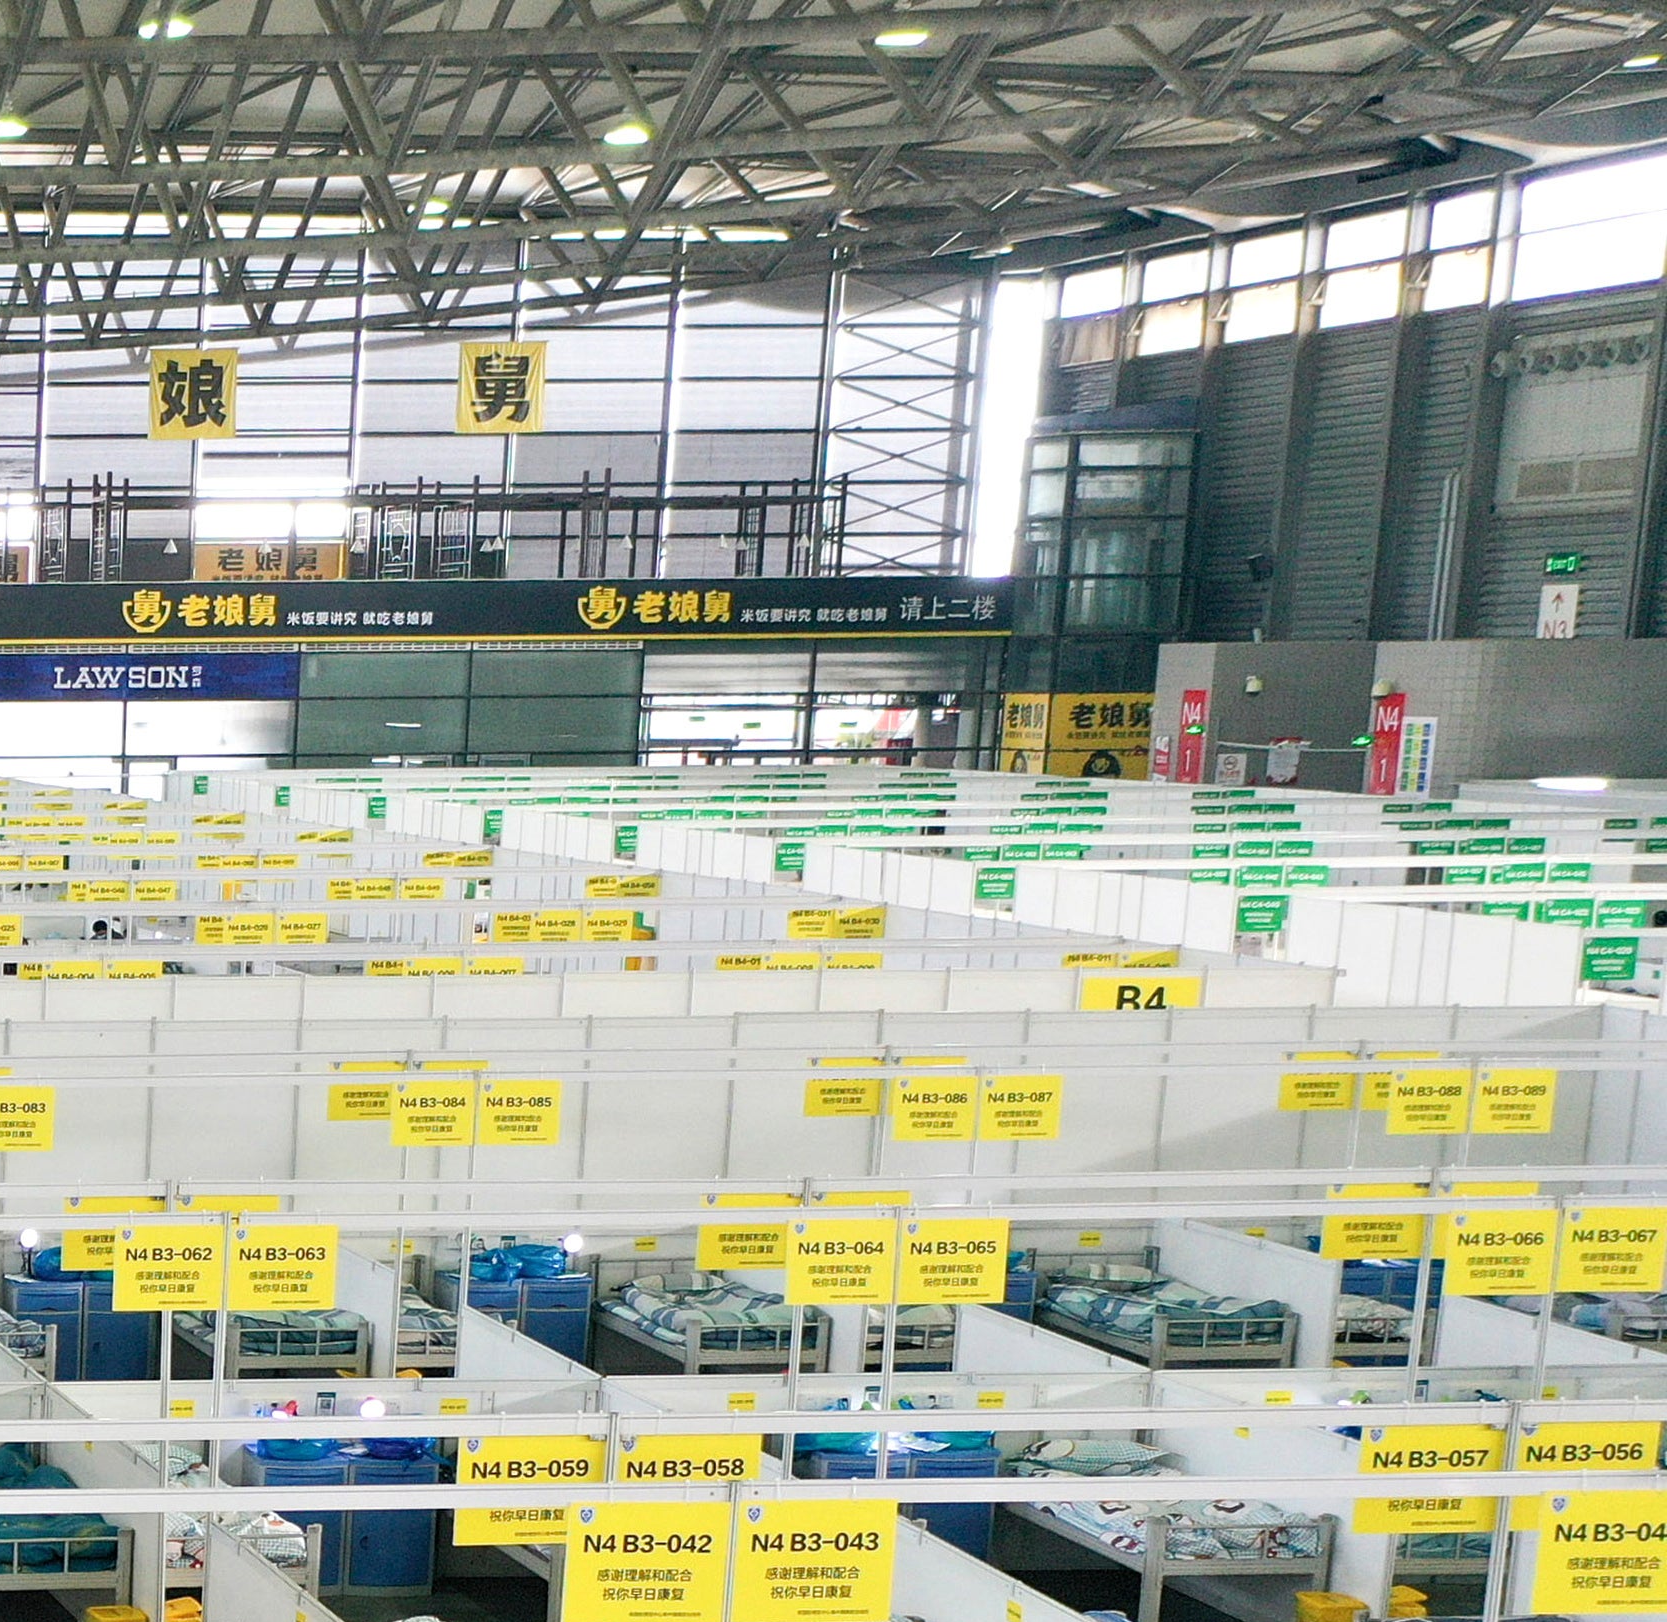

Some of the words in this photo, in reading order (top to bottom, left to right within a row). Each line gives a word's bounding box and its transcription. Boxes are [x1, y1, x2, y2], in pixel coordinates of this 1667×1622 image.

[158, 360, 226, 426] 娘
[471, 353, 530, 424] 舅
[178, 594, 277, 627] 老娘舅
[286, 612, 357, 626] 米饭要讲究
[362, 611, 434, 626] 就吃老娘舅
[632, 590, 731, 624] 老娘舅
[740, 608, 811, 623] 米饭要讲究
[816, 608, 888, 622] 就吃老娘舅
[899, 595, 996, 621] 请上二楼
[53, 667, 189, 689] LAWSON
[1006, 702, 1044, 729] 老娘舅
[1069, 702, 1151, 729] 老娘舅
[1182, 702, 1203, 723] N4
[1376, 706, 1400, 731] N4
[1184, 749, 1192, 772] 1
[1379, 758, 1387, 783] 1
[1116, 986, 1167, 1010] B4
[1458, 1234, 1480, 1245] N4
[1484, 1232, 1544, 1246] B3-066
[1572, 1230, 1594, 1242] N4
[1598, 1229, 1657, 1242] B3-067
[126, 1249, 148, 1261] N4
[152, 1248, 212, 1261] B3-062
[240, 1248, 261, 1260] N4
[266, 1247, 325, 1261] B3-063
[799, 1242, 820, 1254] N4
[825, 1242, 884, 1254] B3-064
[911, 1242, 932, 1254] N4
[937, 1241, 996, 1254] B3-065
[1373, 1451, 1403, 1468] N4
[1409, 1450, 1489, 1467] B3-057
[1526, 1445, 1556, 1462] N4
[1562, 1443, 1643, 1461] B3-056
[472, 1462, 501, 1478] N4
[508, 1459, 588, 1478] B3-059
[627, 1461, 657, 1478] N4
[663, 1459, 744, 1477] B3-058
[584, 1535, 616, 1552] N4
[623, 1535, 712, 1553] B3-042
[752, 1534, 784, 1552] N4
[791, 1533, 879, 1551] B3-043
[597, 1569, 692, 1582] 感谢理解和配合
[766, 1566, 860, 1580] 感谢理解和配合
[771, 1585, 851, 1599] 祝你早日康复
